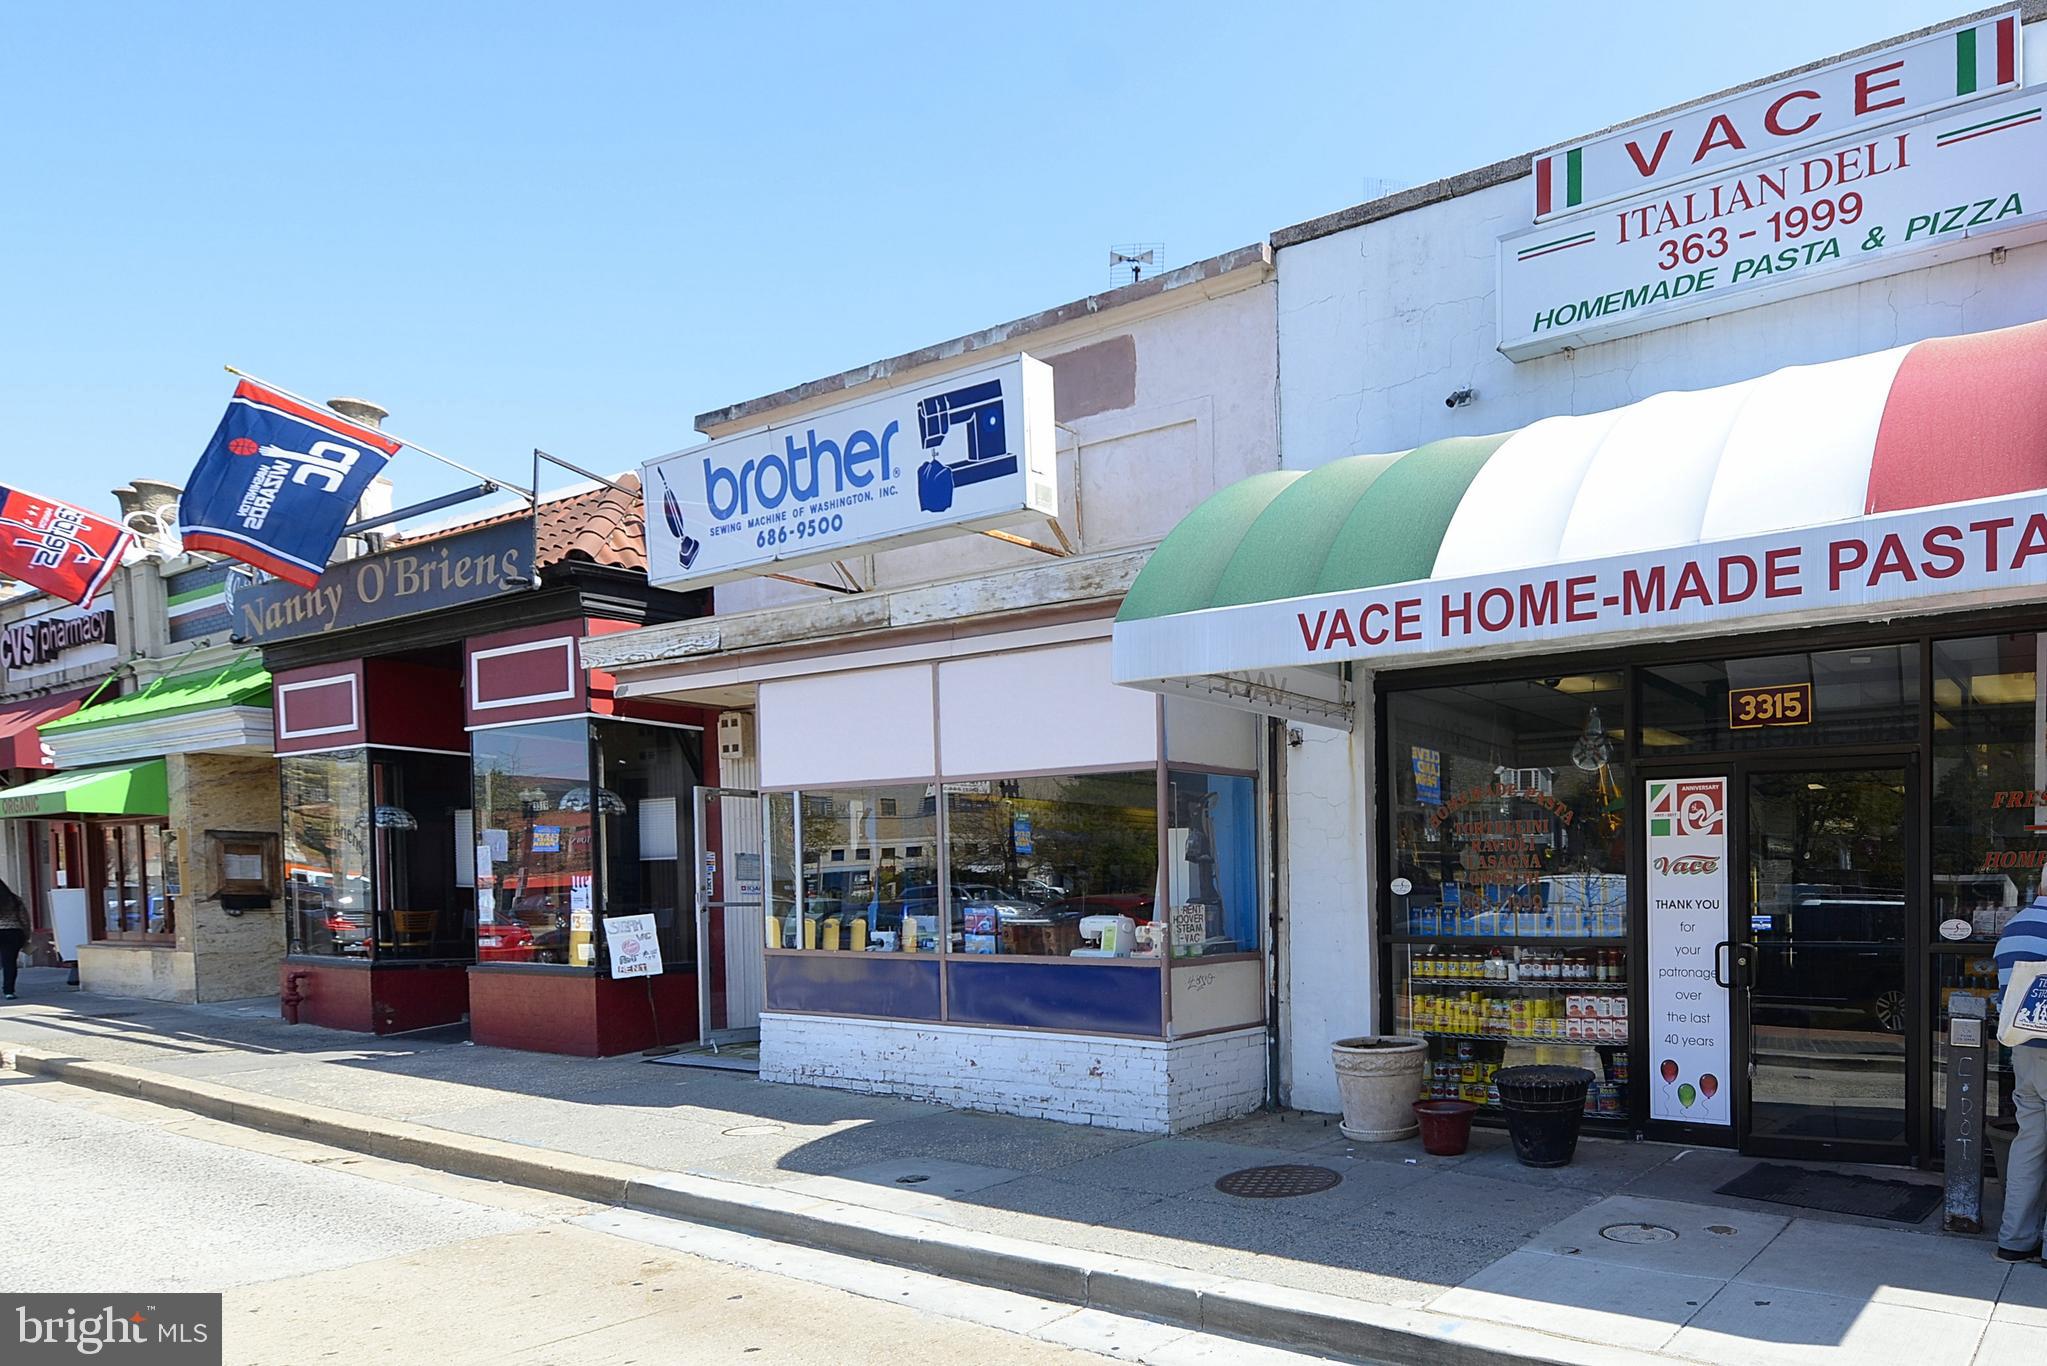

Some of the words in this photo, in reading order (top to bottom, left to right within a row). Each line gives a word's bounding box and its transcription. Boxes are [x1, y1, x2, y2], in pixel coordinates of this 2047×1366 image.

[1625, 60, 1905, 177] VACE
[1616, 167, 1789, 244] ITALIAN
[1801, 132, 1911, 194] DELI
[1532, 267, 1718, 332] HOMEMADE
[1731, 238, 1840, 283] PASTA
[1860, 225, 1884, 251] &
[1904, 192, 2023, 242] PIZZA
[709, 521, 742, 537] SEWING
[747, 511, 787, 528] MACHINE
[793, 507, 804, 518] OF
[879, 485, 899, 498] INC.
[756, 513, 844, 549] 686-9500
[1298, 598, 1422, 651] VACE
[1441, 547, 1803, 637] HOME-MADE
[1828, 512, 2047, 591] PASTA
[240, 585, 342, 641] Nanny
[356, 547, 521, 603] O'Briens
[1738, 692, 1802, 721] 3315
[2, 795, 39, 815] ORGANIC
[1455, 819, 1549, 836] TORTELLINI
[1471, 835, 1536, 853] RAVIOLI
[1466, 853, 1542, 870] LASAGNA
[1653, 855, 1720, 876] Vace
[1655, 899, 1693, 910] THANK
[1695, 899, 1720, 910] YOU
[1173, 914, 1204, 924] HOOVER
[1680, 921, 1695, 932] for
[1176, 923, 1202, 934] STEAM
[1675, 945, 1701, 957] your
[1658, 966, 1717, 981] patronage
[1675, 990, 1702, 1001] over
[1667, 1012, 1687, 1023] the
[1690, 1012, 1711, 1024] last
[1664, 1033, 1679, 1045] 40
[1682, 1036, 1715, 1047] years
